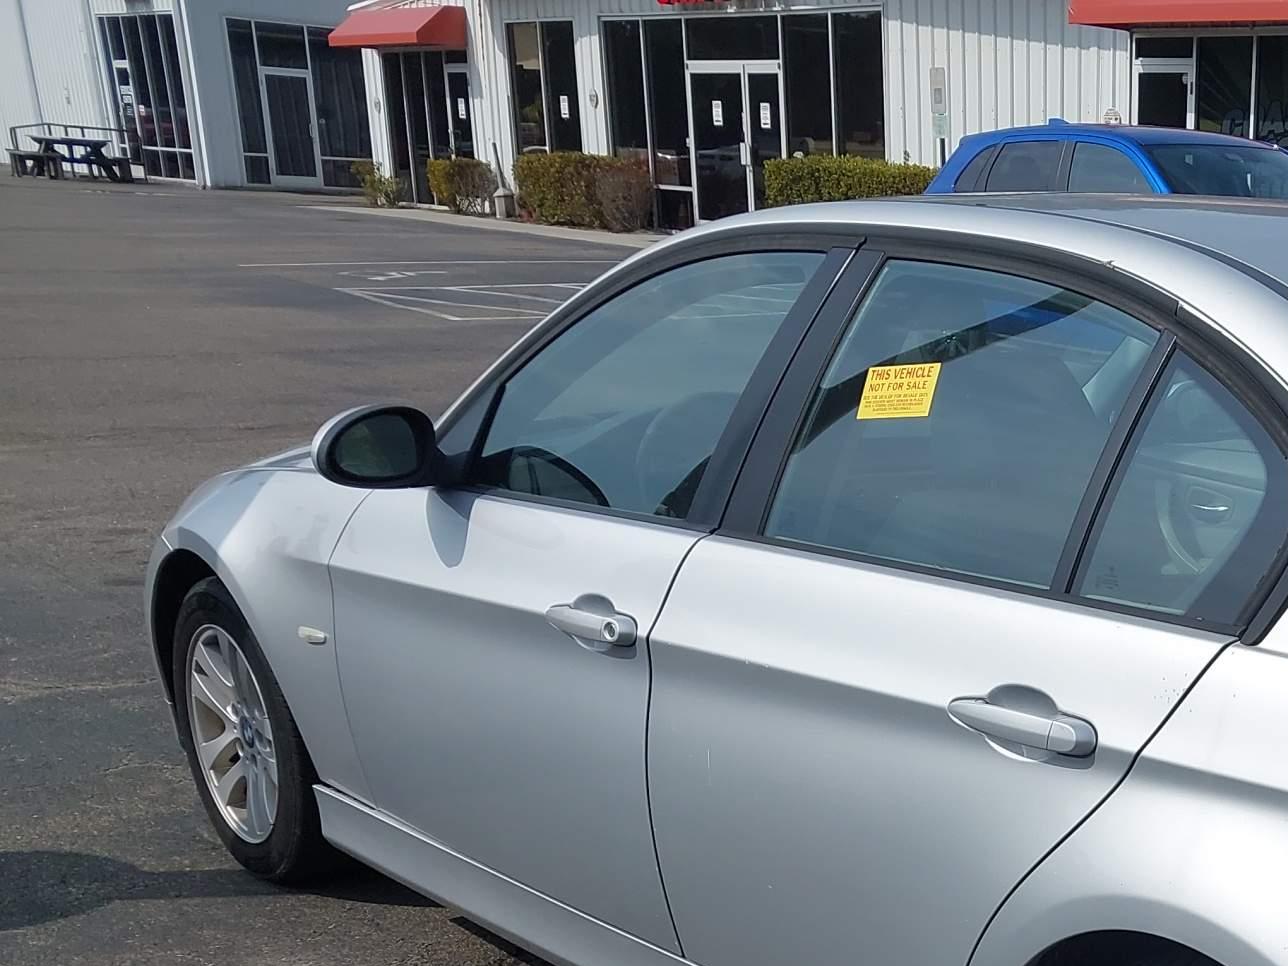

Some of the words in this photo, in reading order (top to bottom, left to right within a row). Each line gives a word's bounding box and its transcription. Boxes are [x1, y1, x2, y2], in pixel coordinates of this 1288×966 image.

[871, 369, 891, 380] THIS
[894, 366, 934, 379] VEHICLE
[868, 383, 886, 392] NOT
[887, 382, 905, 392] FOR
[906, 381, 928, 390] SALE
